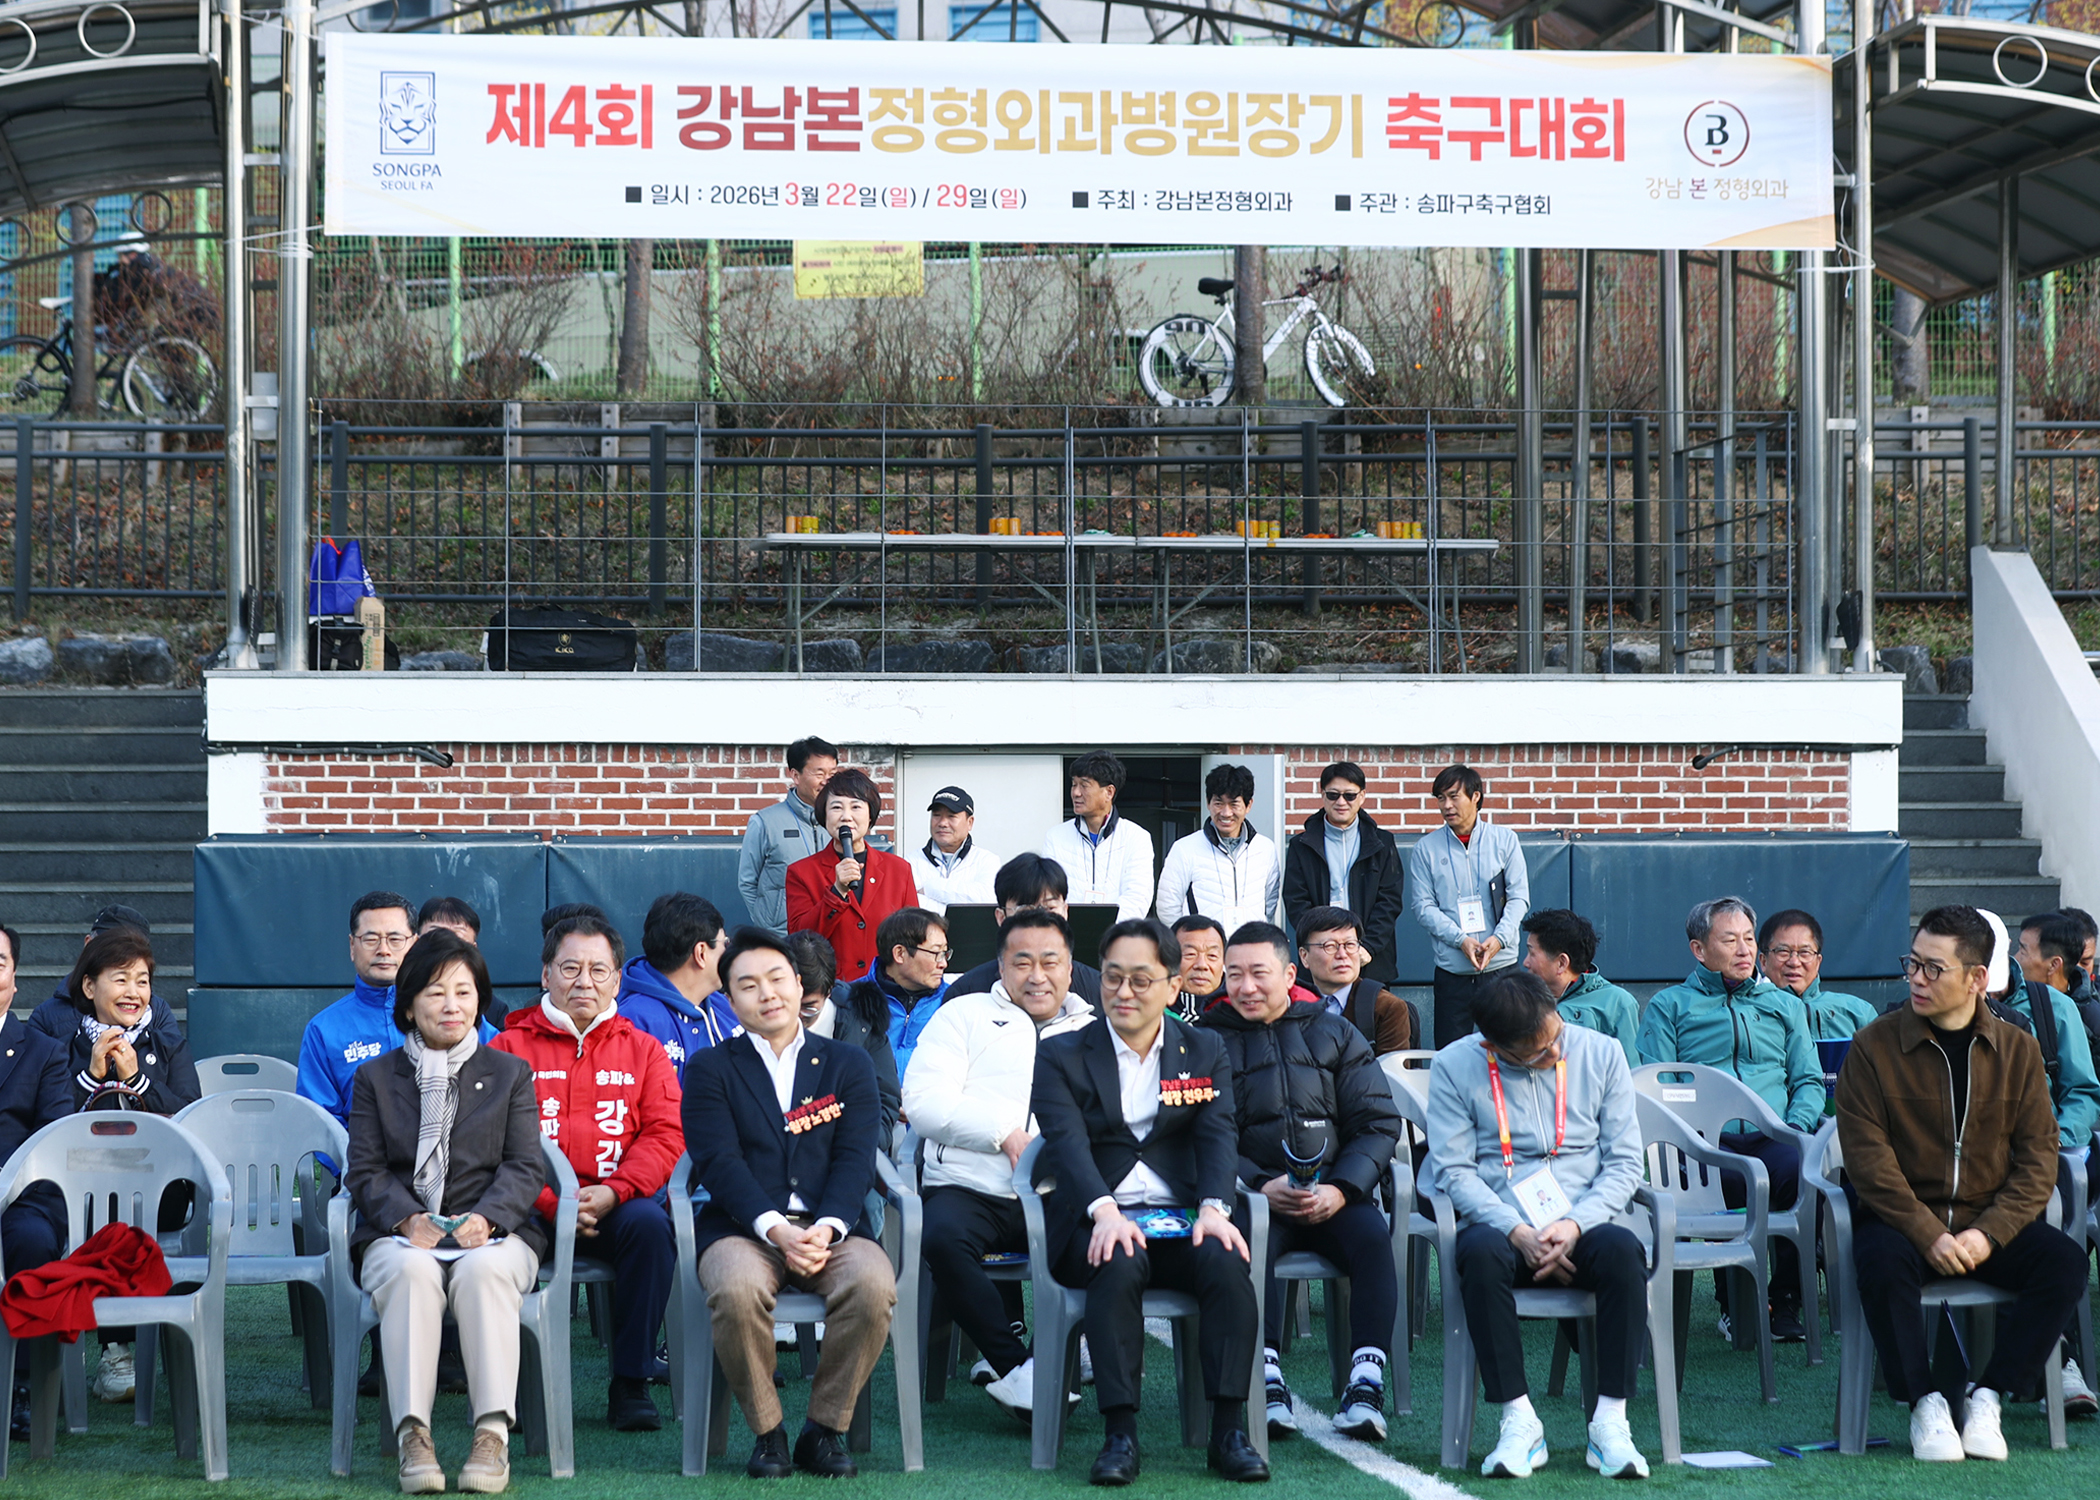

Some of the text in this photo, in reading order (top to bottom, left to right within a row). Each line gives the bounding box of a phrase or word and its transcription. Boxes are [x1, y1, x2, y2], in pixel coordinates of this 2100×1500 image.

[487, 83, 1625, 161] 제4회 강남본정형외과병원장기 축구대회
[373, 163, 442, 177] SONGPA
[381, 180, 434, 191] SEOUL FA
[651, 184, 689, 205] 일시
[711, 185, 779, 207] 2026년
[785, 182, 819, 207] 3월
[826, 182, 917, 208] 22일(일)
[937, 184, 1027, 210] 29일(일)
[1646, 178, 1789, 201] 강남 본 정형외과
[1097, 190, 1135, 211] 주최
[1156, 190, 1293, 212] 강남본정형외과
[1359, 193, 1397, 214] 주관
[1417, 193, 1551, 216] 송파구축구협회
[344, 1042, 382, 1063] 민주당
[596, 1070, 635, 1086] 송파&
[1162, 1090, 1183, 1106] 원장
[788, 1115, 812, 1135] 원장
